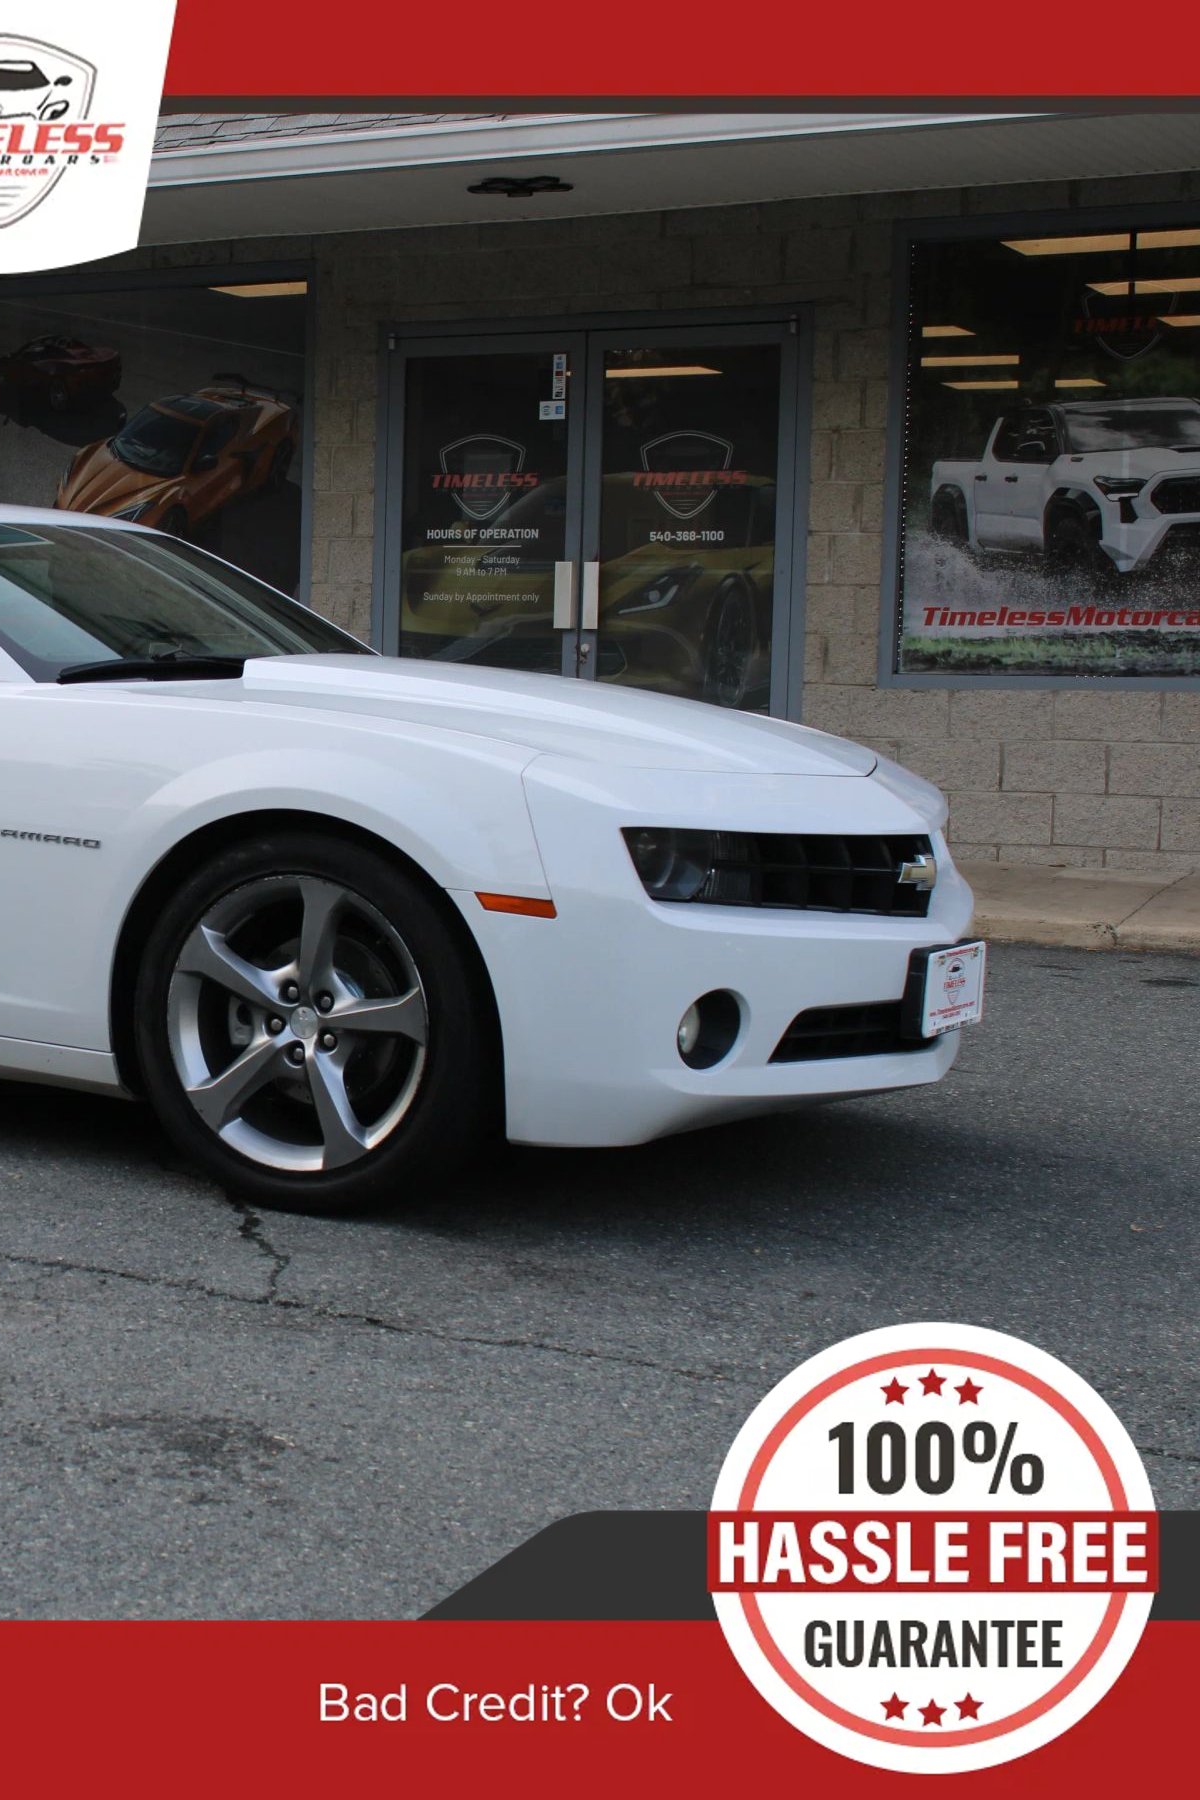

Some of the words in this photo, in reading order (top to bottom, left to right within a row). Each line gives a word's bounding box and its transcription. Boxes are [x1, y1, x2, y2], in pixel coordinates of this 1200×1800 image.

[431, 472, 539, 488] TIMELESS
[632, 470, 749, 487] TIMELESS
[426, 529, 462, 540] HOURS
[463, 529, 478, 539] OF
[479, 528, 540, 540] OPERATION
[649, 530, 725, 542] 540-368-1100
[443, 555, 476, 566] Monday
[482, 555, 521, 566] Saturday
[463, 567, 476, 576] AM
[477, 567, 487, 576] to
[494, 567, 508, 577] PM
[423, 591, 453, 603] Sunday
[455, 592, 465, 602] by
[466, 592, 521, 603] Appointment
[521, 592, 540, 603] only
